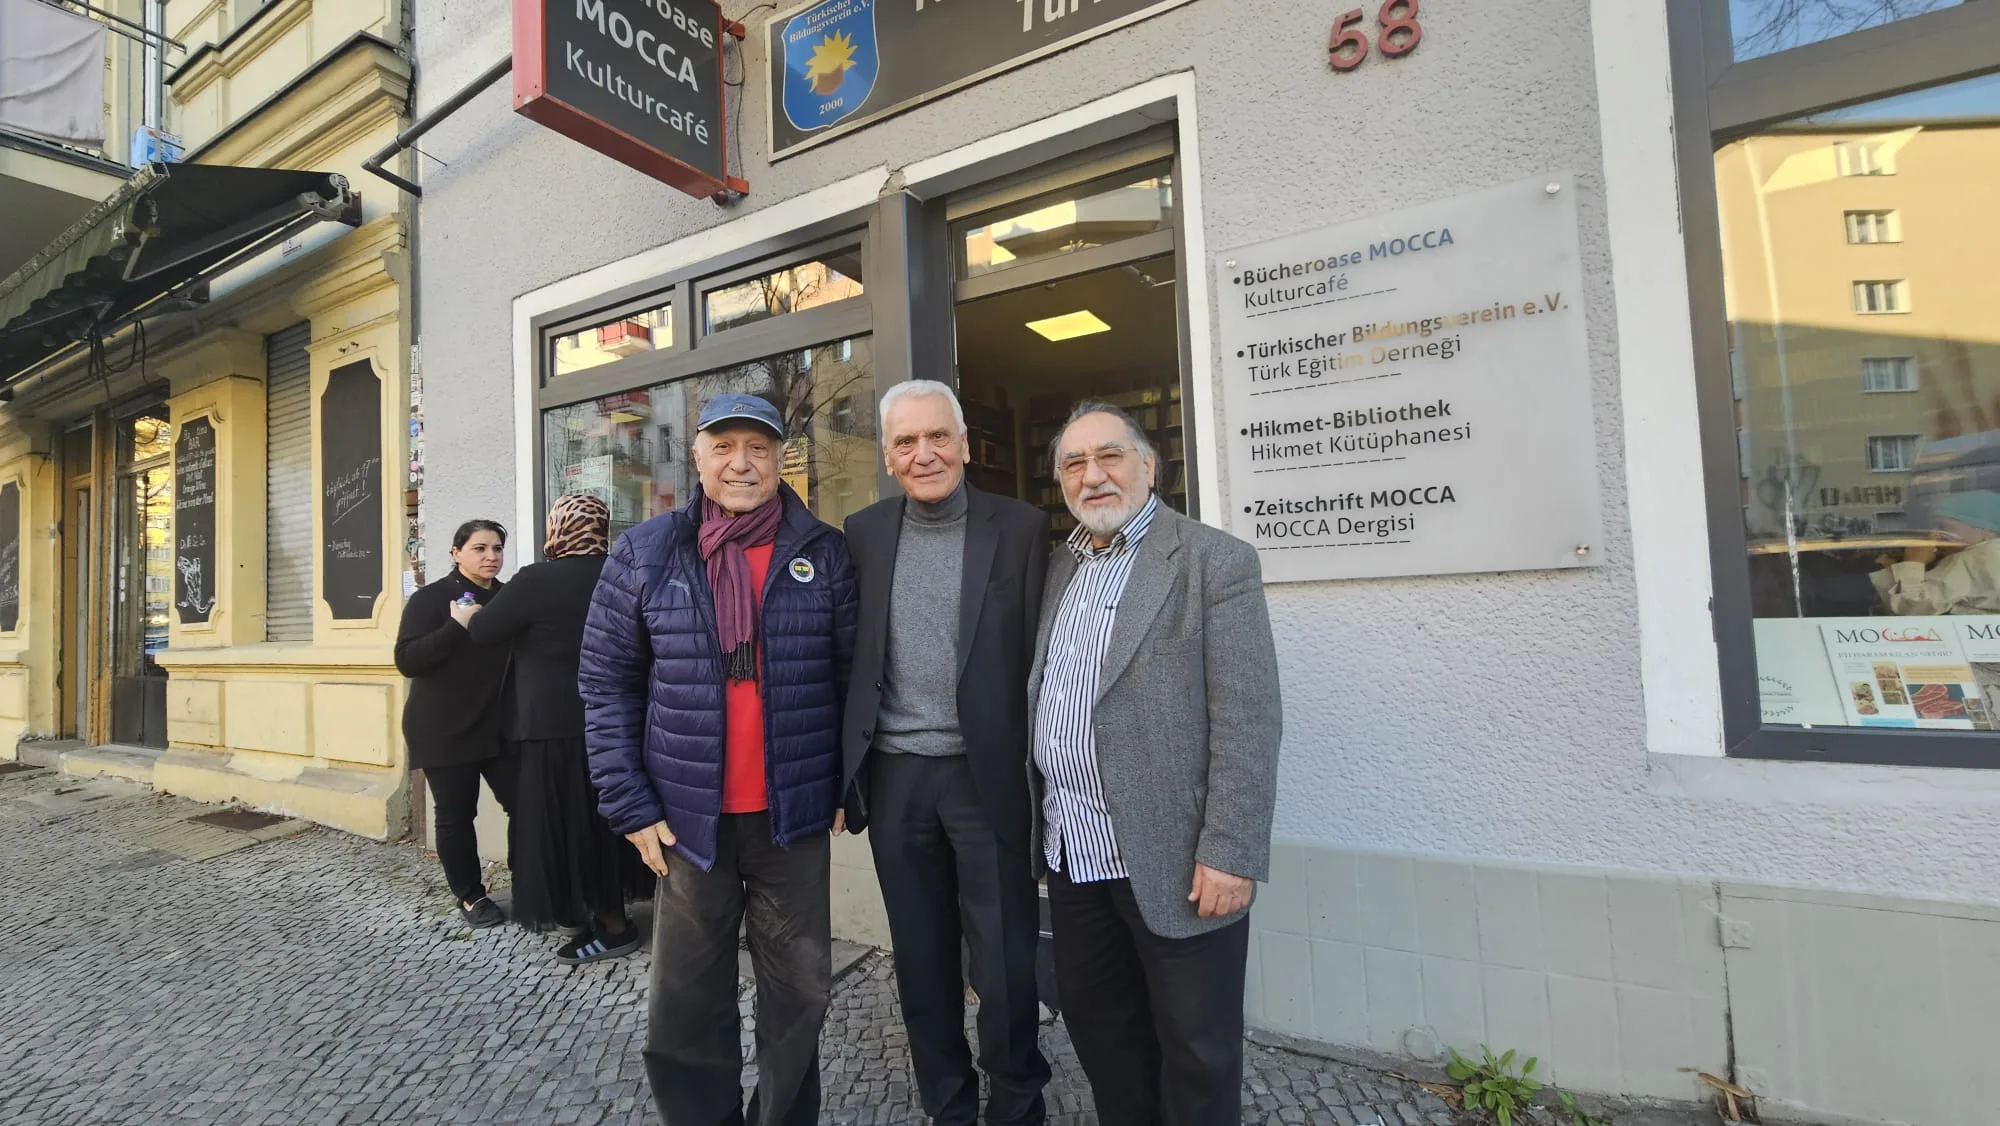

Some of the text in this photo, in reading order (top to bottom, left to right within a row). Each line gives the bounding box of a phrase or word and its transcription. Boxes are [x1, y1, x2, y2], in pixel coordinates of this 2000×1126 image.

[789, 8, 852, 43] Bildungsverein
[1328, 0, 1422, 73] 58
[576, 0, 699, 92] MOCCA
[566, 41, 710, 145] Kulturcafé
[819, 97, 844, 115] 2000
[1243, 228, 1455, 287] Bücheroase MOCCA
[1244, 273, 1349, 310] Kulturcafé
[1247, 292, 1569, 361] Türkischer Bildungsverein e.V.
[1248, 364, 1292, 383] Türk
[1298, 352, 1365, 379] Eğitim
[1250, 400, 1452, 439] Hikmet-Bibliothek
[1251, 422, 1472, 462] Hikmet Kütüphanesi
[1255, 485, 1456, 517] Zeitschrift MOCCA
[1256, 513, 1415, 539] MOCCA Dergisi
